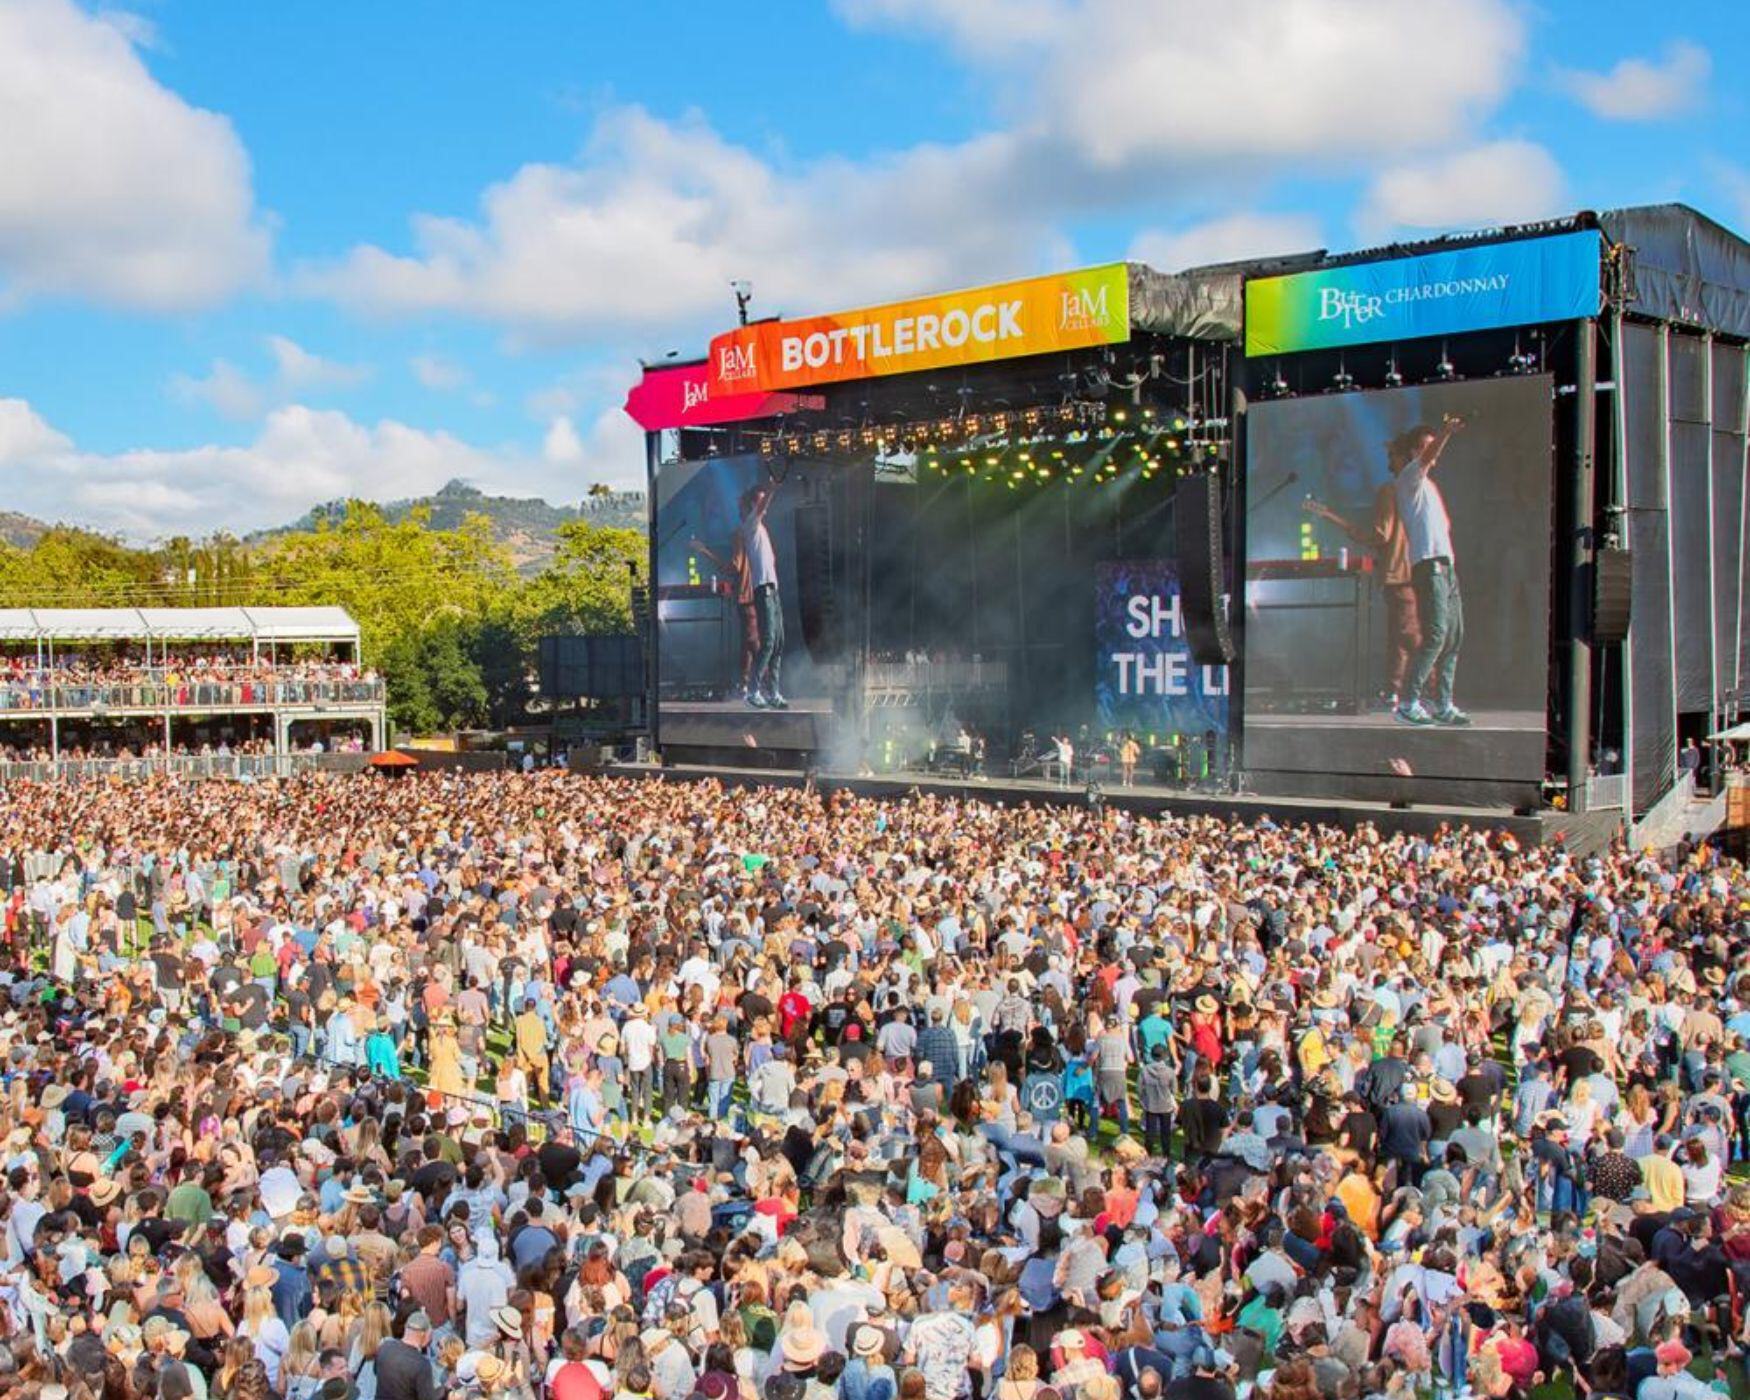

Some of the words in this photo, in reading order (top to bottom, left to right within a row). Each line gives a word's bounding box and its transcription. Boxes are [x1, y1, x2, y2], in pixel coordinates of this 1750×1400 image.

[1385, 274, 1509, 303] CHARDONNAY
[782, 301, 1023, 371] BOTTLEROCK
[1111, 652, 1187, 695] THE
